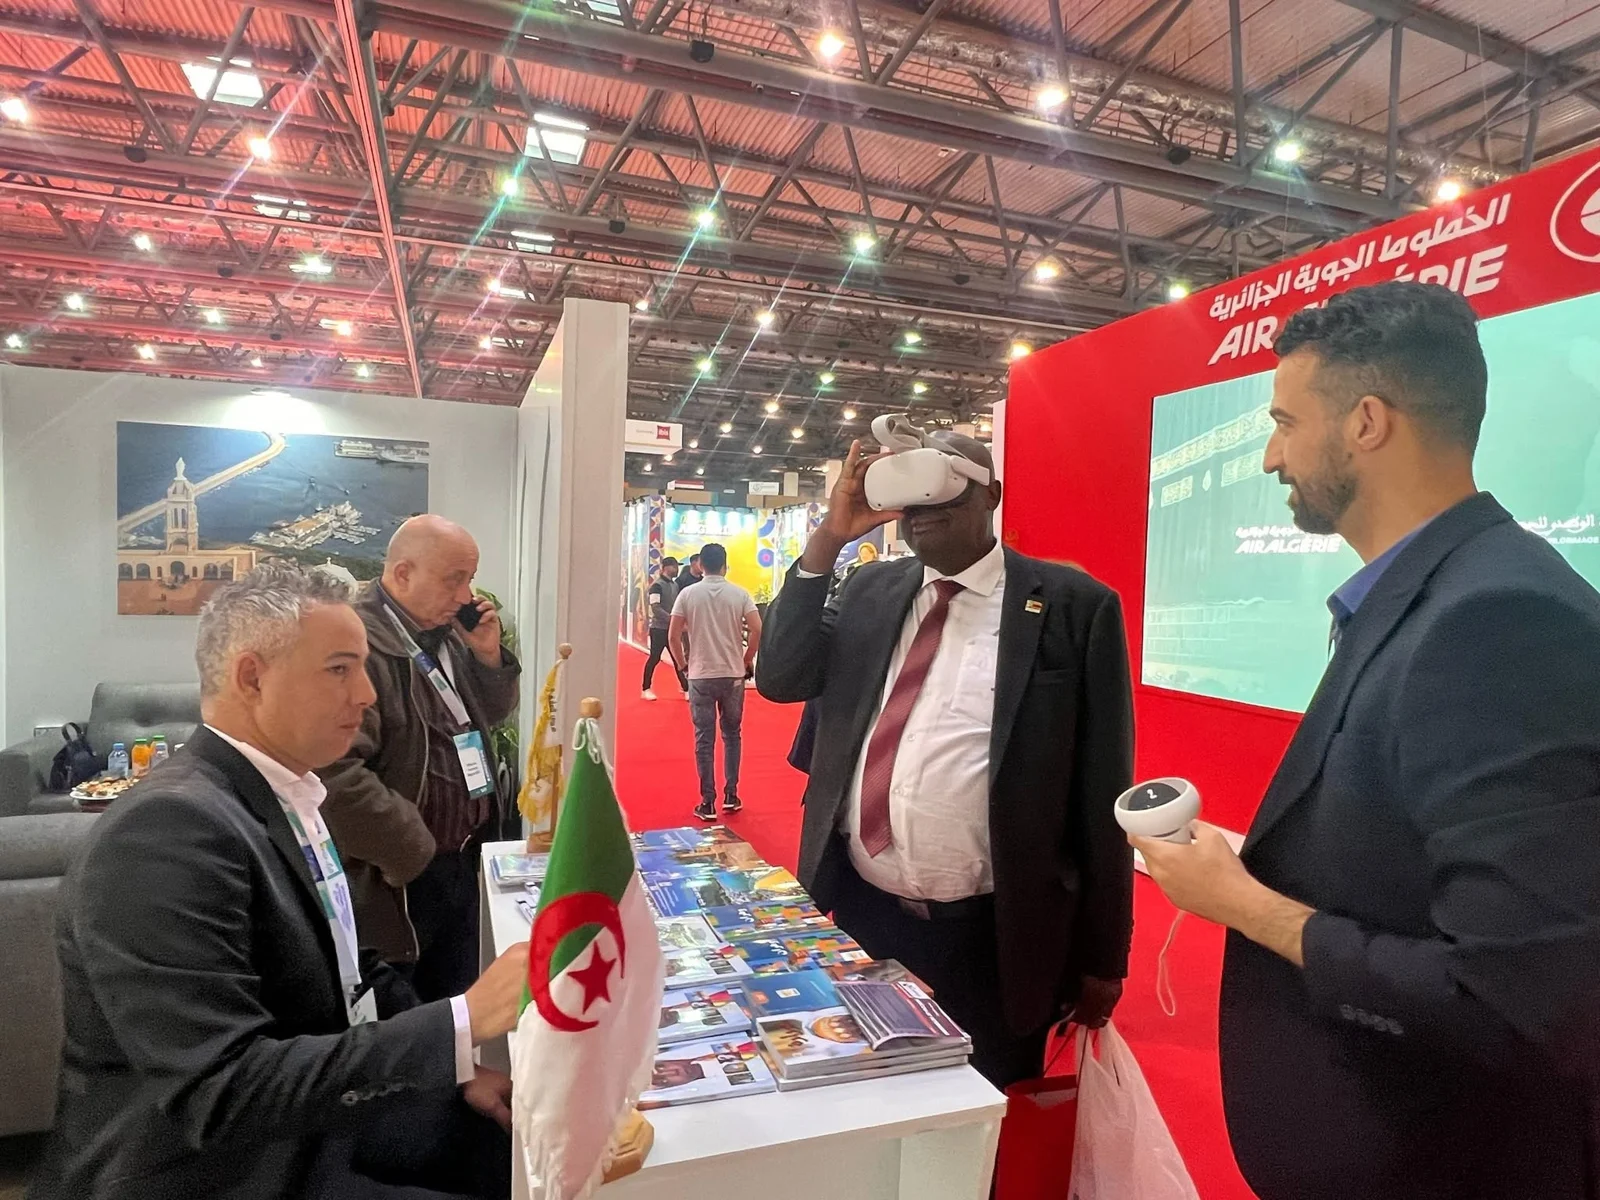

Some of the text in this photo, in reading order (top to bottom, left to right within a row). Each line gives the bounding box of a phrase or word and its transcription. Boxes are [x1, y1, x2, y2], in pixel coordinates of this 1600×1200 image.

[1378, 193, 1512, 263] الخطوط
[1293, 240, 1376, 295] الجوية
[1209, 270, 1292, 321] الجزائرية
[1207, 316, 1278, 366] AIR
